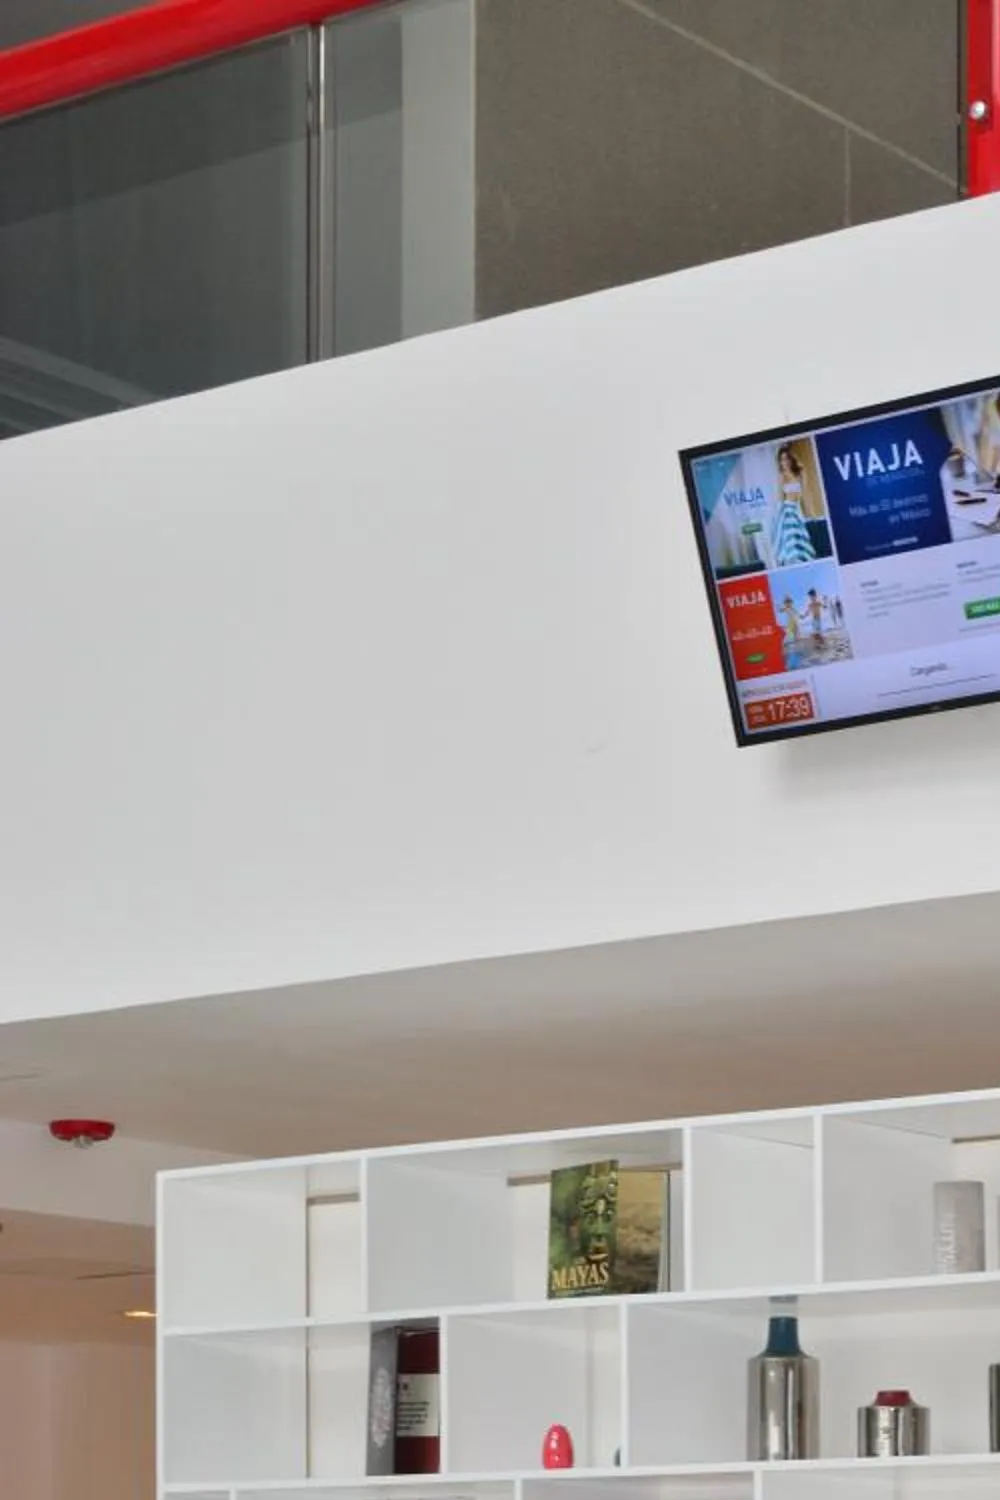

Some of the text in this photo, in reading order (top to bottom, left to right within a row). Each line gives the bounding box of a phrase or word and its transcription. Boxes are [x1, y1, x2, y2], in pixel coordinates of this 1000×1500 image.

[833, 439, 924, 481] VIAJA
[723, 486, 765, 507] VIAJA
[725, 590, 767, 609] VIAJA
[551, 1262, 610, 1291] MAYAS
